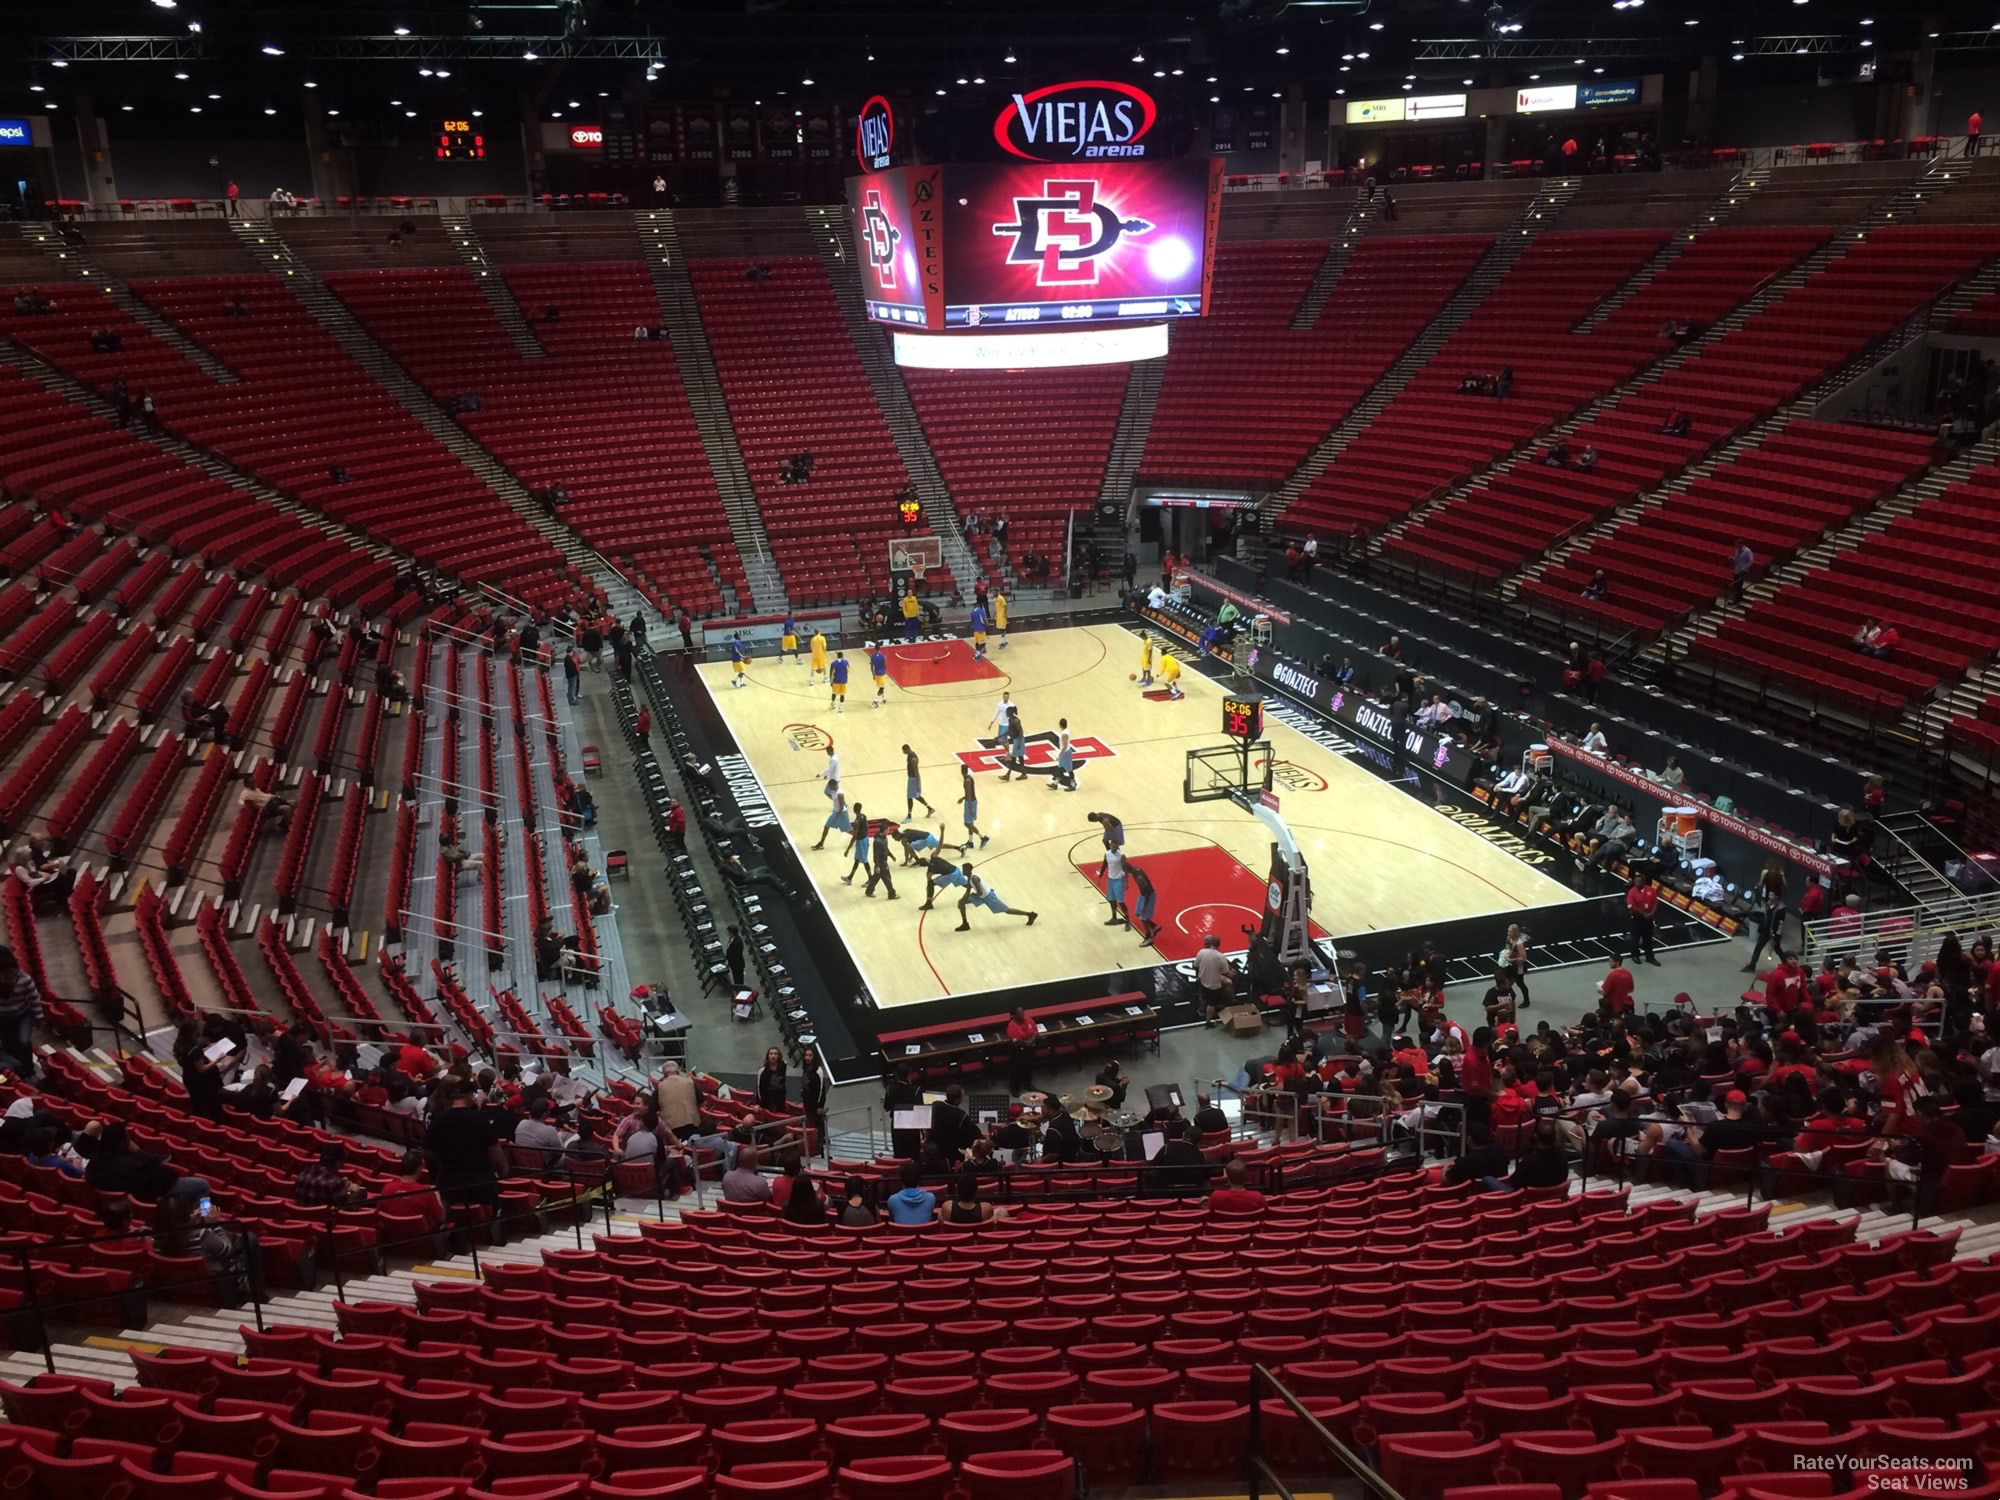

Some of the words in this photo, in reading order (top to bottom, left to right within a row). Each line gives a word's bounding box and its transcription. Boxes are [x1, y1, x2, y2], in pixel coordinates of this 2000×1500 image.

[858, 112, 889, 159] VIEJAS
[1012, 93, 1134, 156] VIEJAS
[1086, 144, 1145, 157] arena
[918, 182, 939, 294] AZTECS
[904, 511, 917, 522] 35
[1273, 663, 1319, 698] @GOAZTECS
[1225, 701, 1251, 716] 62:06
[790, 724, 825, 748] VIEJAS
[1229, 713, 1248, 735] 35
[1305, 728, 1365, 756] STATE
[715, 753, 754, 780] STATE
[727, 779, 768, 807] DIEGO
[741, 807, 779, 828] SAN
[1554, 741, 1575, 755] TOYOTA
[1583, 753, 1605, 769] TOYOTA
[1614, 768, 1637, 785] TOYOTA
[1648, 784, 1672, 800] TOYOTA
[1720, 816, 1747, 835] TOYOTA
[1759, 834, 1787, 854] TOYOTA
[1801, 854, 1831, 874] TOYOTA
[1434, 804, 1556, 865] @GOAZTECS
